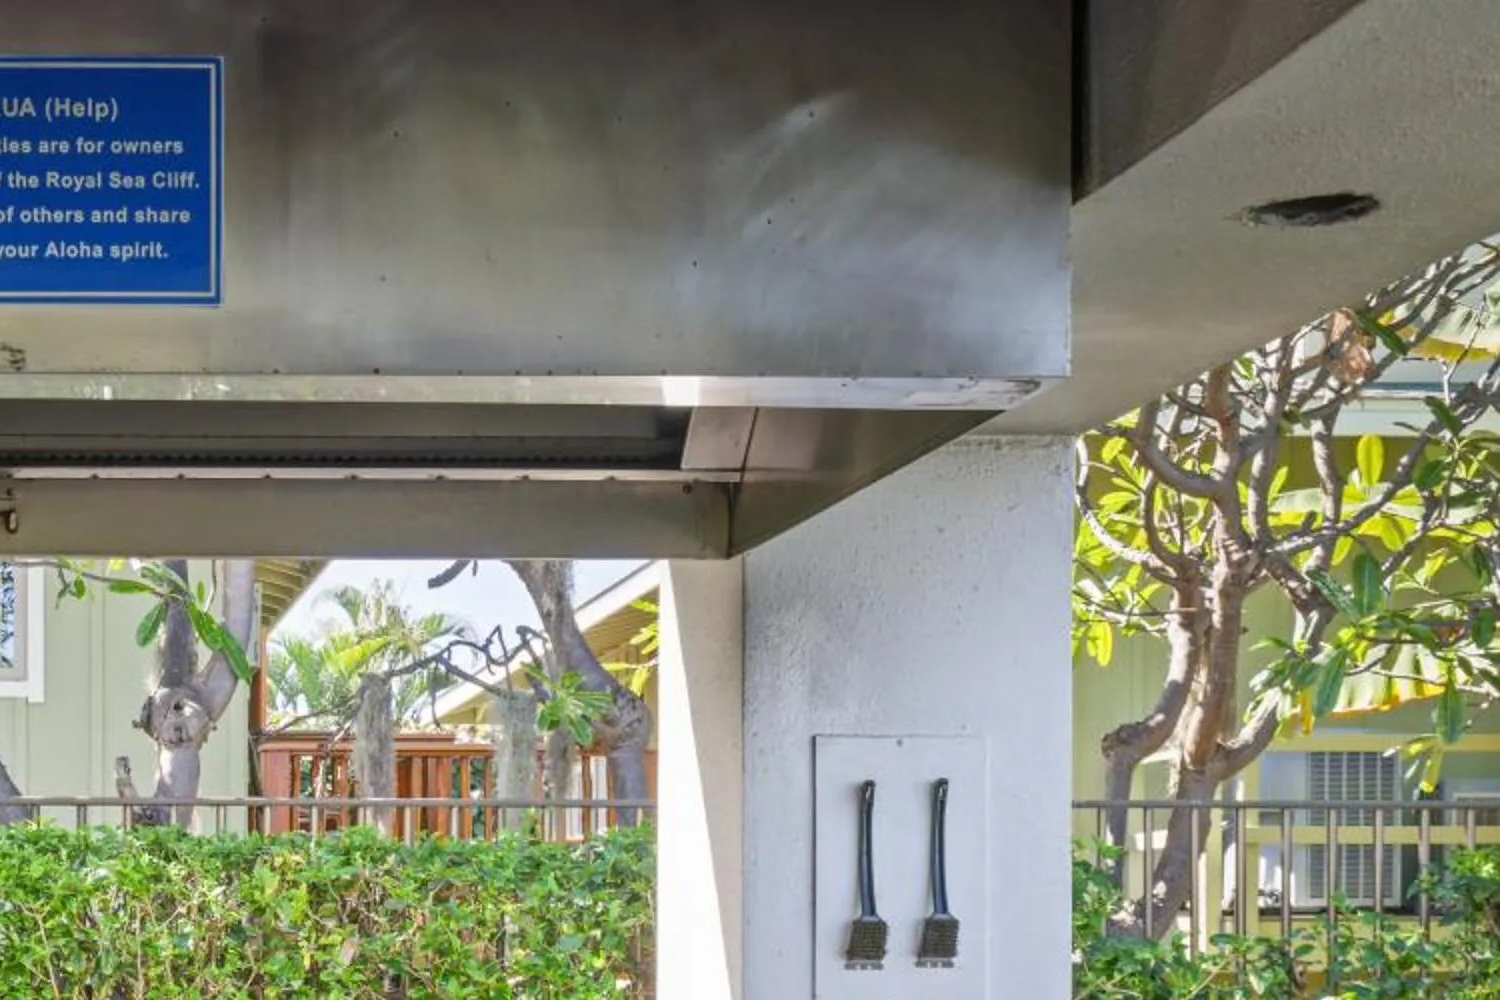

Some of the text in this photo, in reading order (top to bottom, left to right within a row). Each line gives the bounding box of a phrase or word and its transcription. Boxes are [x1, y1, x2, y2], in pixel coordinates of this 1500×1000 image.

[45, 97, 118, 122] (Help)
[38, 139, 70, 154] are
[75, 136, 105, 154] for
[110, 139, 184, 154] owners
[7, 171, 39, 189] the
[45, 171, 102, 193] Royal
[109, 171, 146, 189] Sea
[152, 171, 200, 189] Cliff.
[19, 206, 85, 223] others
[91, 206, 128, 224] and
[134, 206, 191, 223] share
[44, 241, 103, 259] Aloha
[109, 241, 168, 262] spirit.
